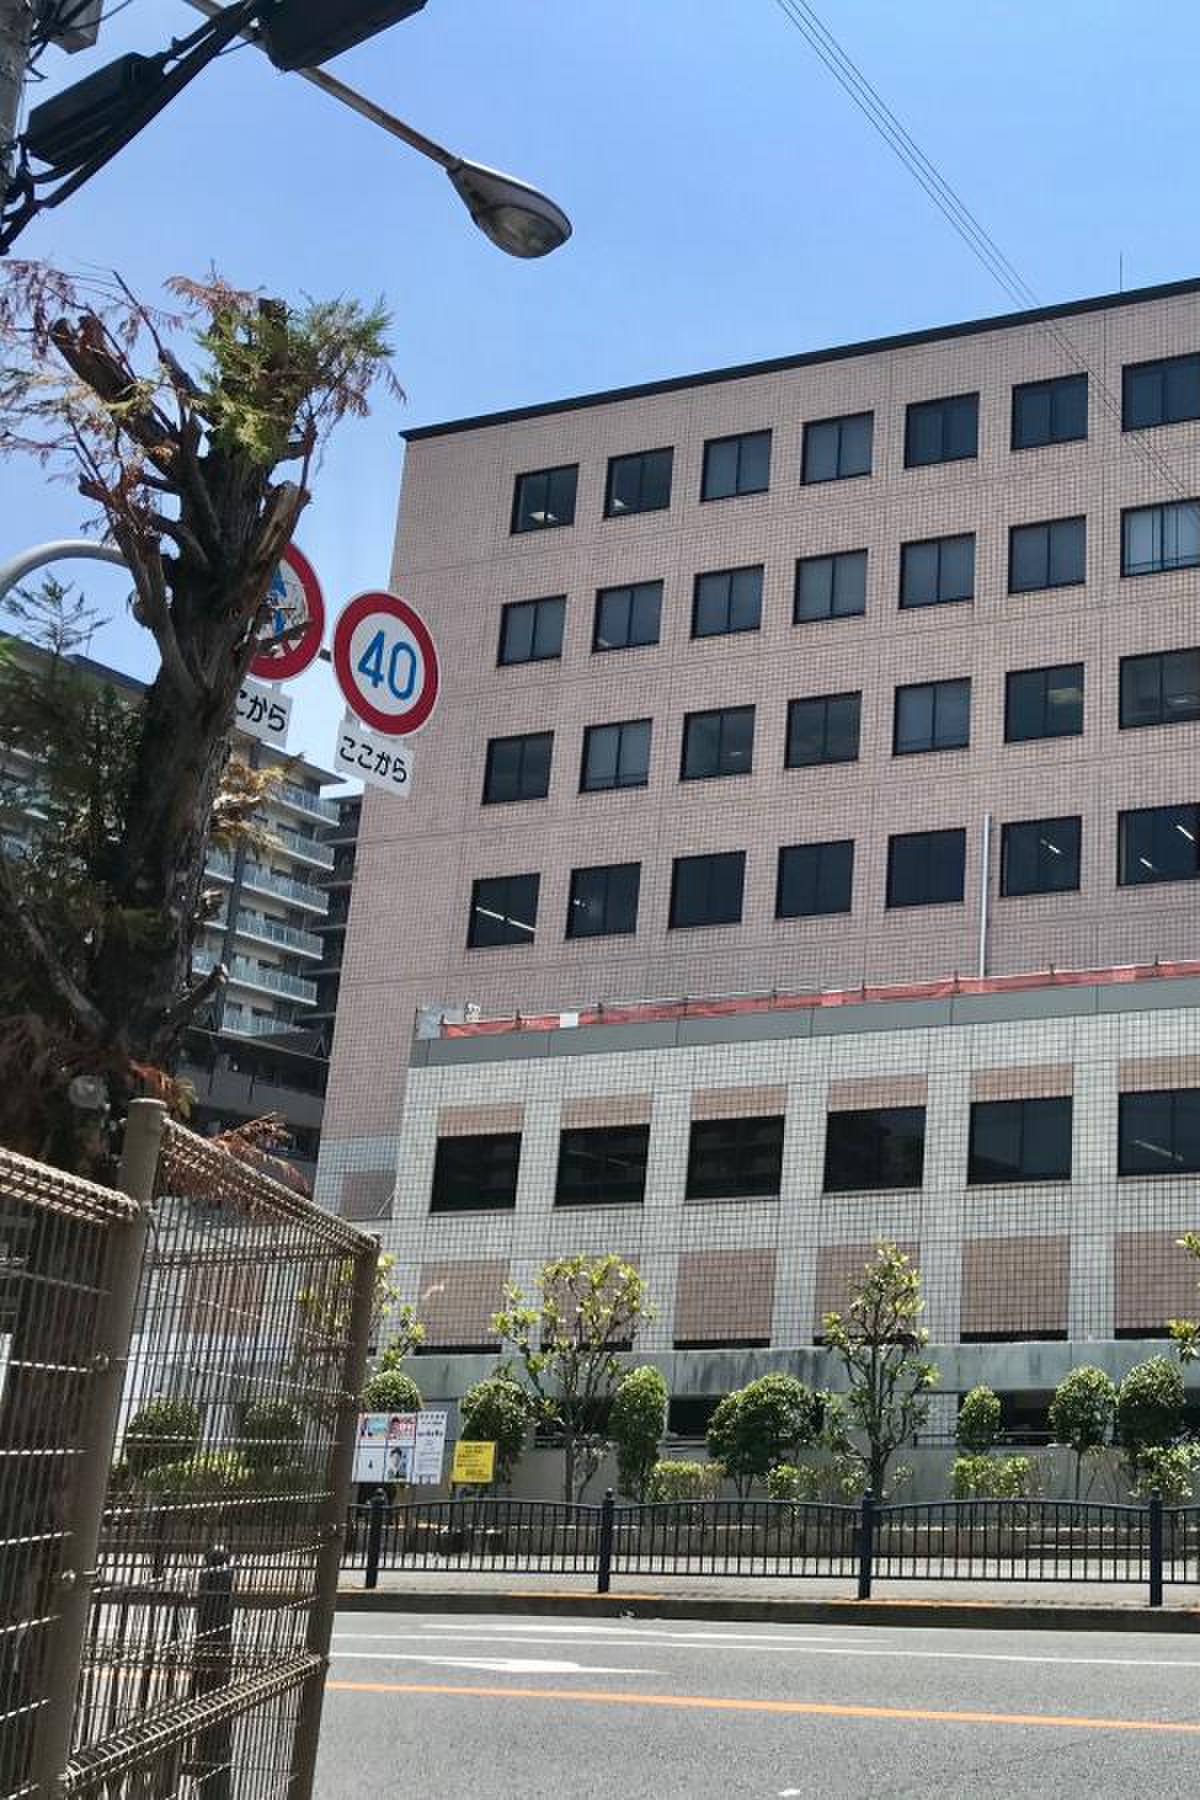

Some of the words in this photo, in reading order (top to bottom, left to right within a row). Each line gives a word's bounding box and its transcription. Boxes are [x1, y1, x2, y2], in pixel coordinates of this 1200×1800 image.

[357, 629, 417, 701] 40
[235, 688, 287, 732] こから
[339, 735, 407, 783] ここから
